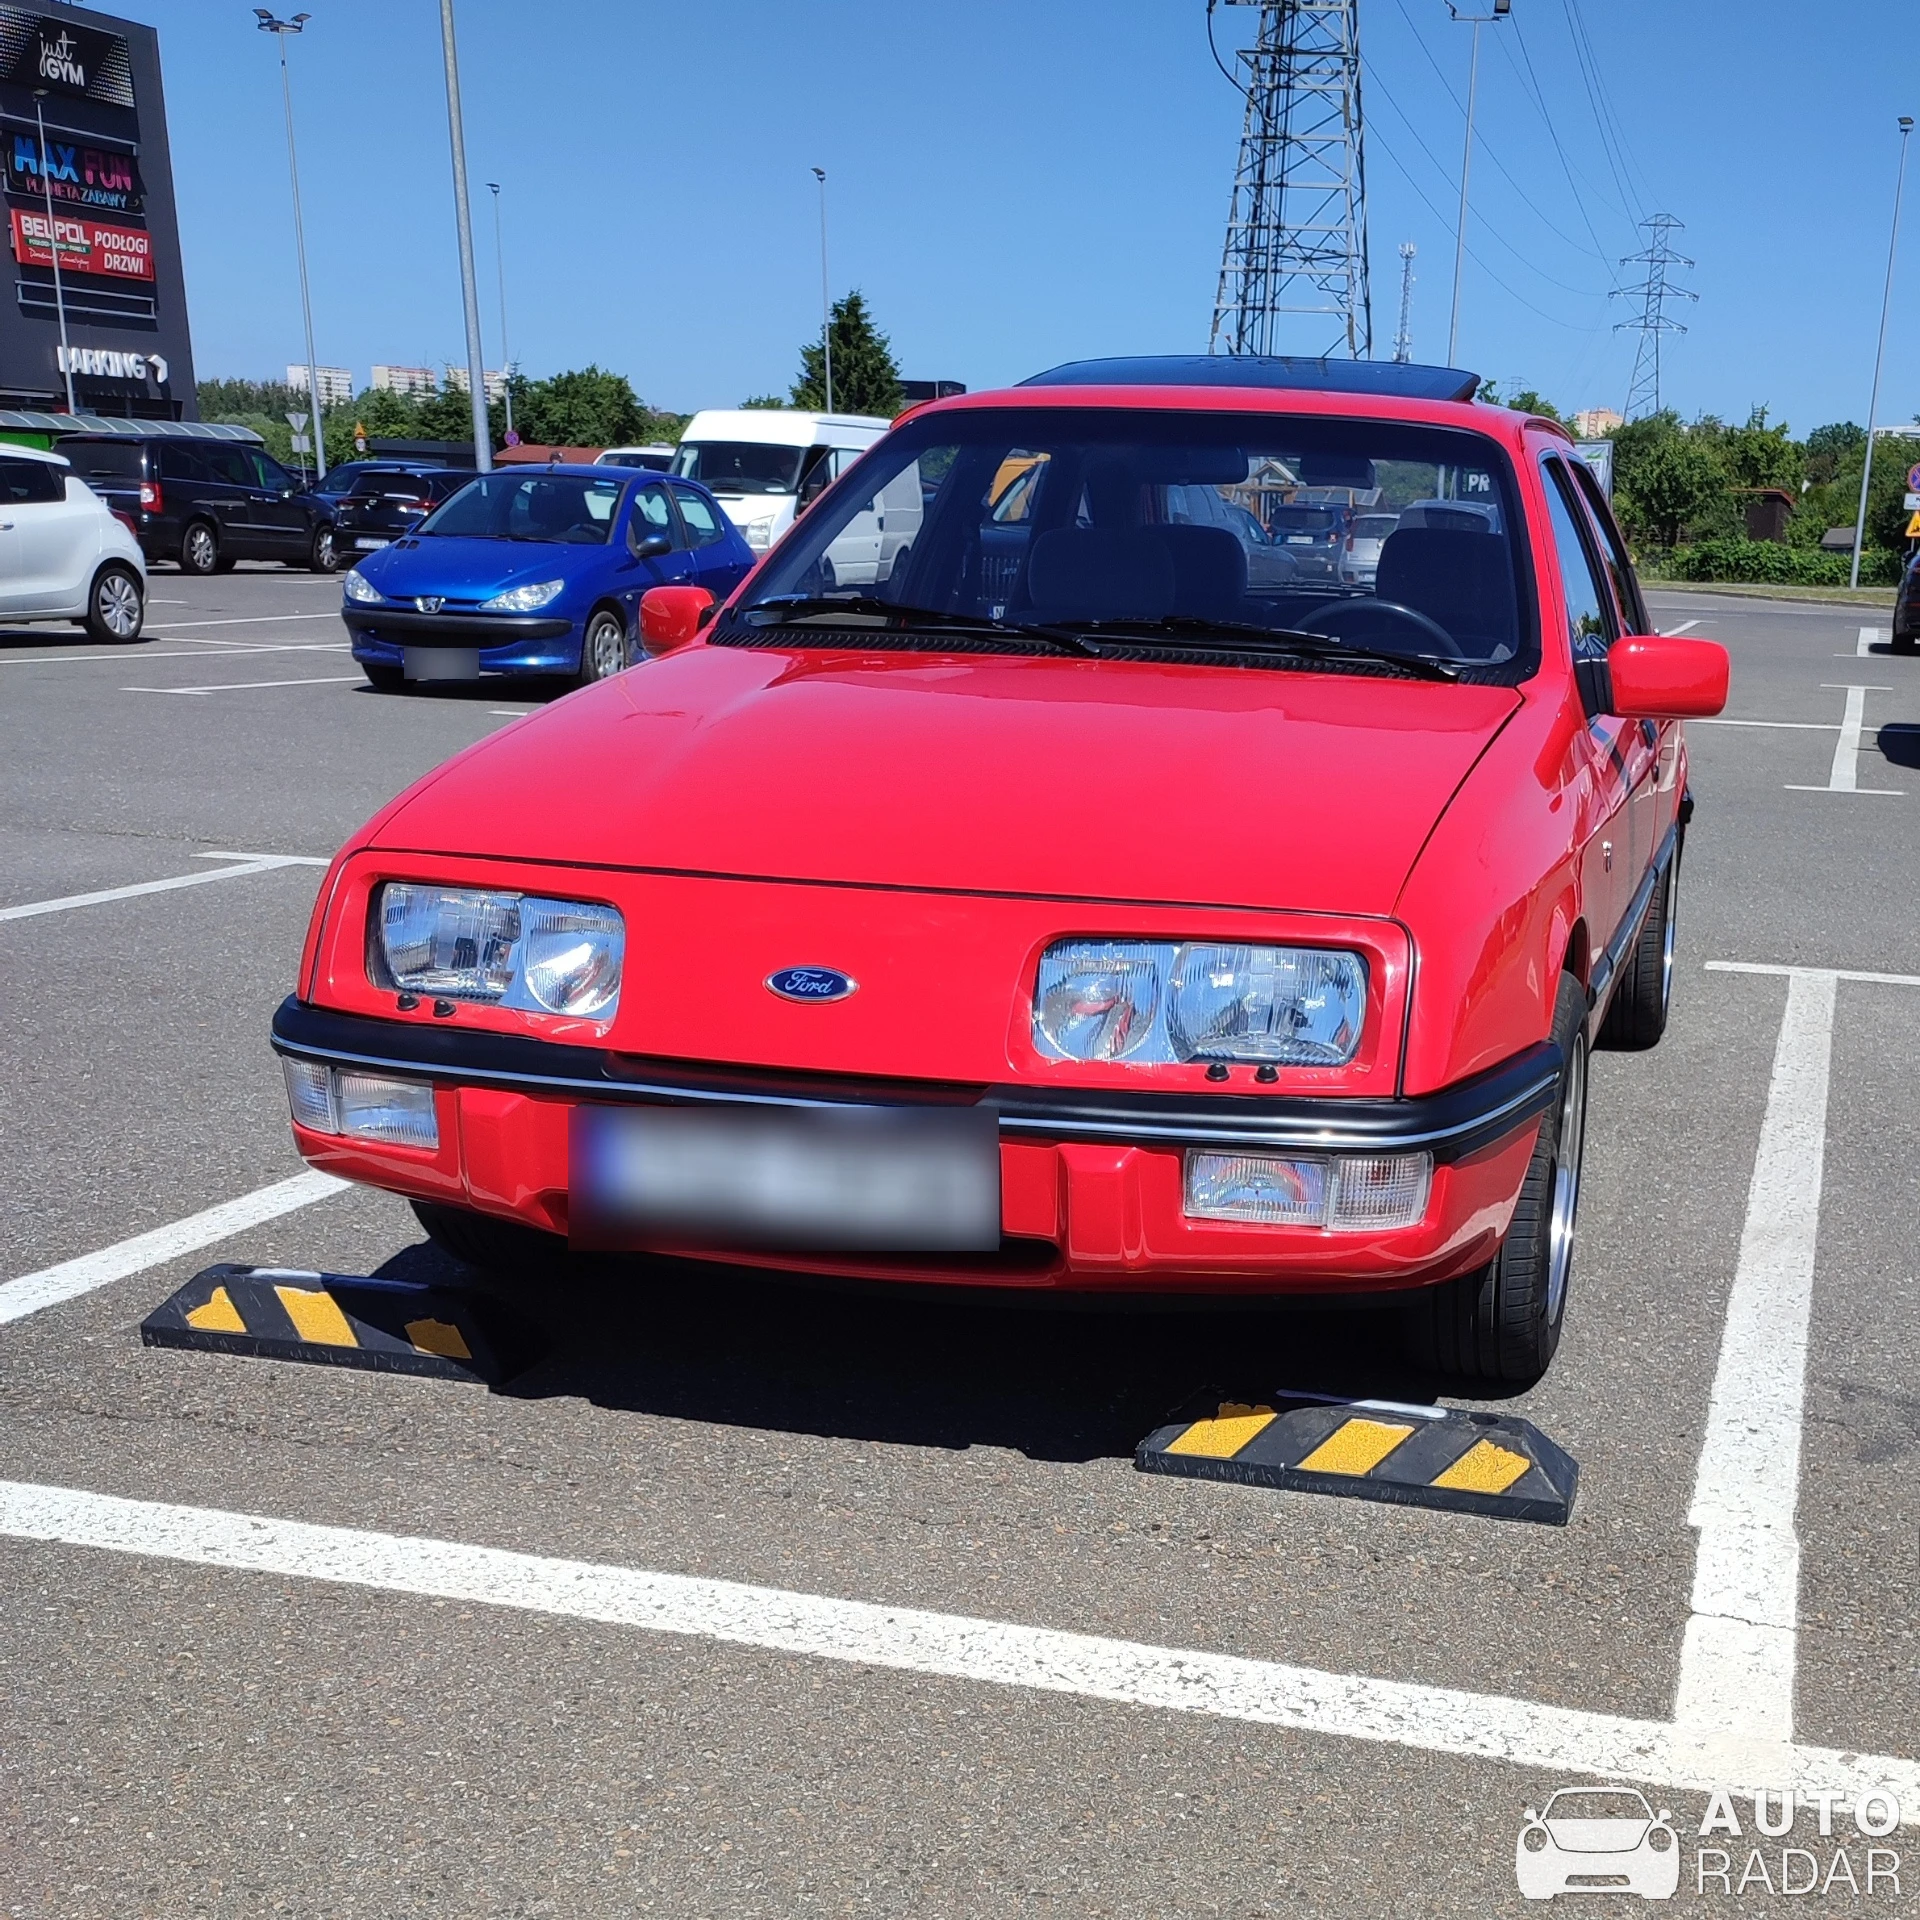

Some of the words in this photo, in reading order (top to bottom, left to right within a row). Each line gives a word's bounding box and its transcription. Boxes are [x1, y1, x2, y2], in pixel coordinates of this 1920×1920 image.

[39, 30, 77, 77] just
[46, 60, 85, 86] GYM
[14, 136, 79, 183] MAX
[84, 150, 132, 191] FUN
[20, 214, 91, 245] BELPOL
[94, 230, 148, 255] PODŁOGI
[104, 254, 144, 274] DRZWI
[784, 970, 834, 994] Ford
